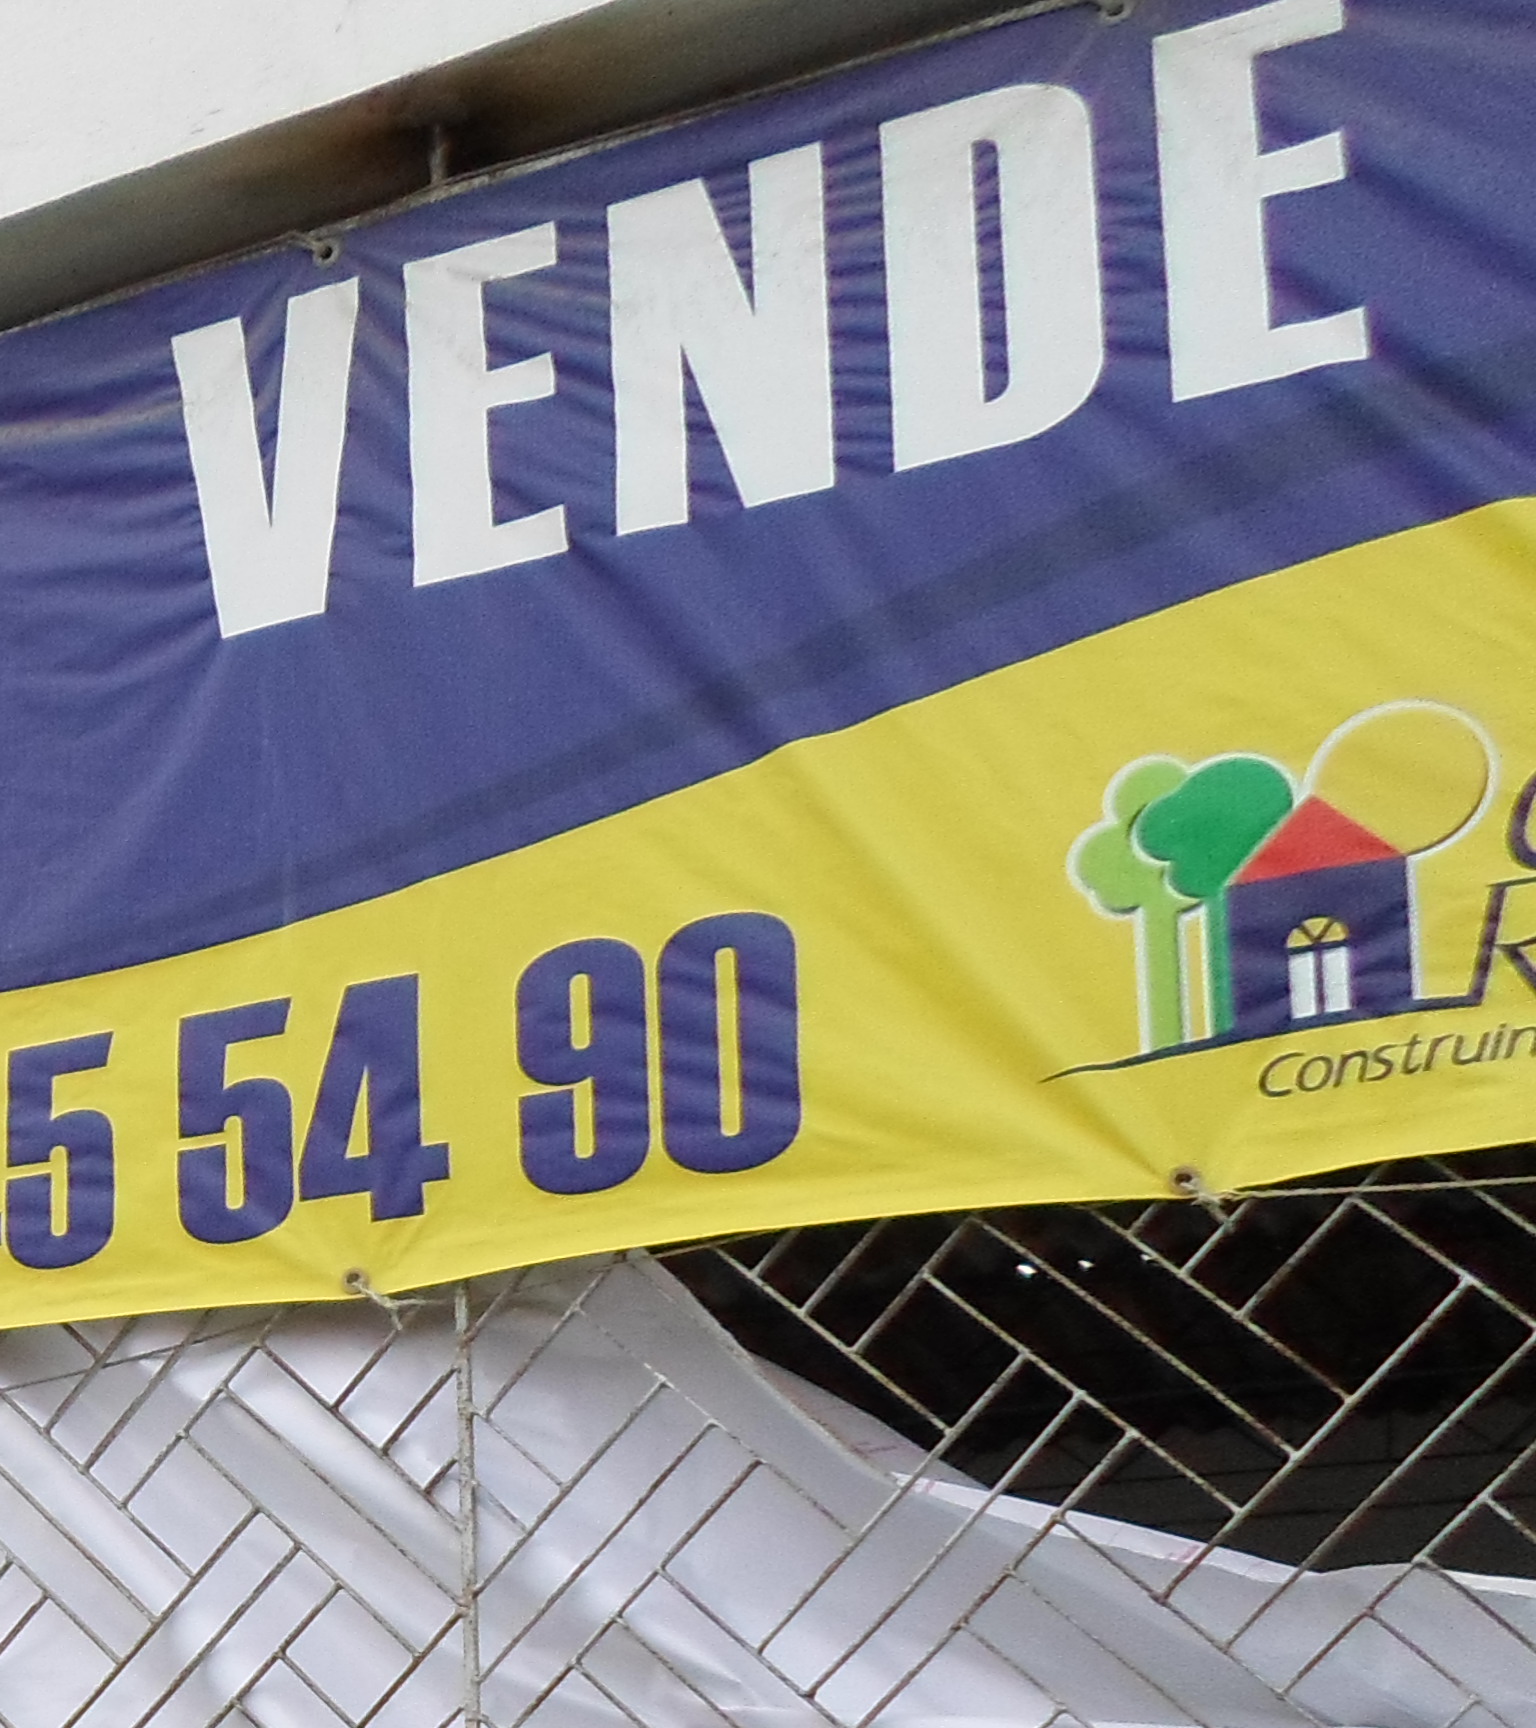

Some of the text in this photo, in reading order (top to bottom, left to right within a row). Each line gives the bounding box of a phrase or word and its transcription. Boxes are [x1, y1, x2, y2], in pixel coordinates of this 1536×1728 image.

[170, 0, 1371, 640] VENDE
[178, 974, 451, 1245] 54
[517, 912, 804, 1196] 90
